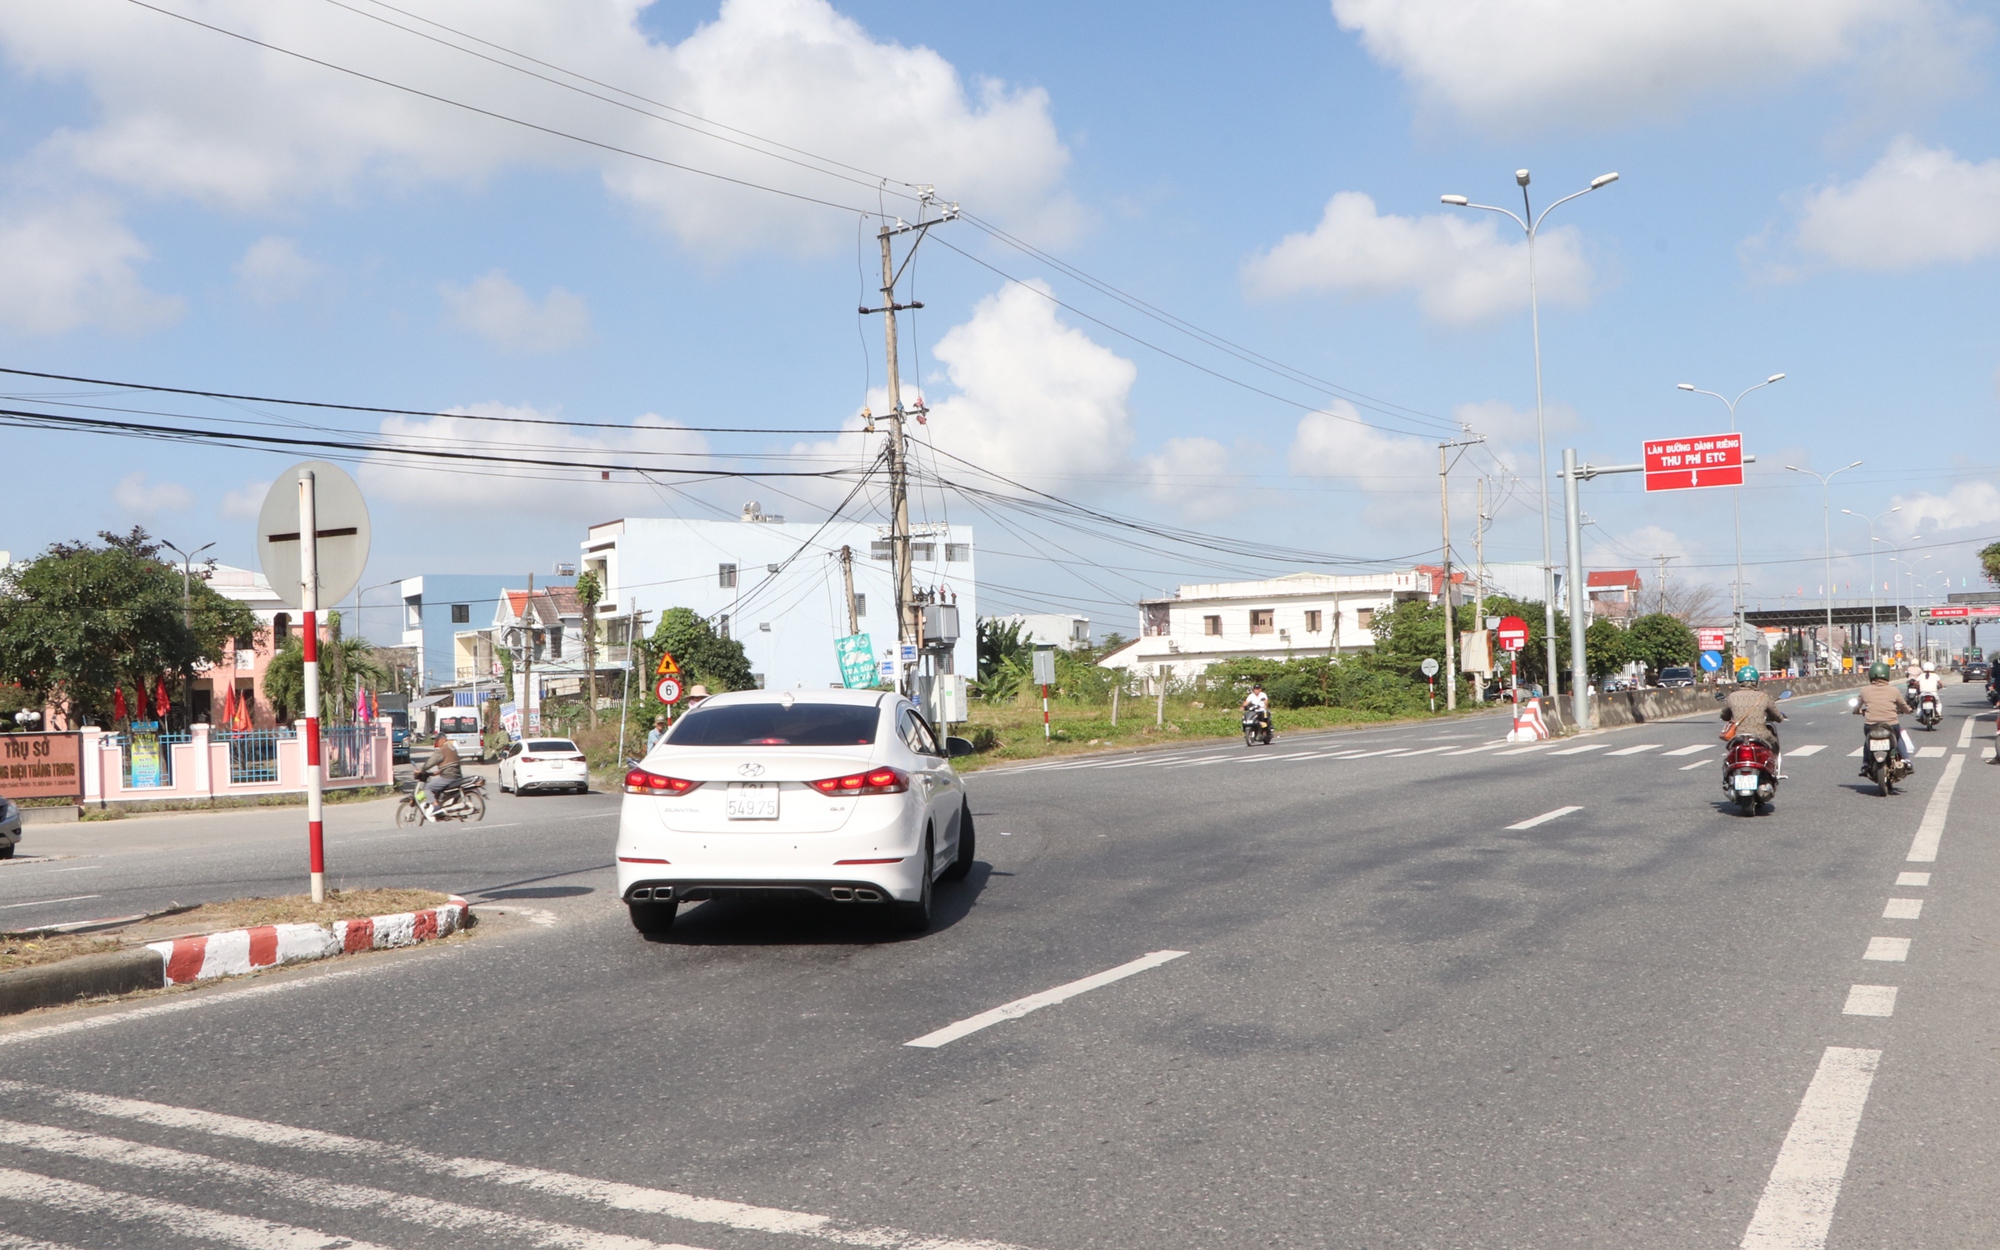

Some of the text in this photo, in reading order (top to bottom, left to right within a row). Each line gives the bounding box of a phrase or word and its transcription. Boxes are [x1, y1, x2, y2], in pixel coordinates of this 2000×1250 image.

[1647, 438, 1739, 455] LÀN ĐƯỜNG DÀNH RIÊNG
[1661, 452, 1726, 467] THU PHÍ ETC
[4, 735, 50, 760] TRỤ SỞ
[740, 783, 765, 798] 43A
[729, 800, 776, 815] 549.75
